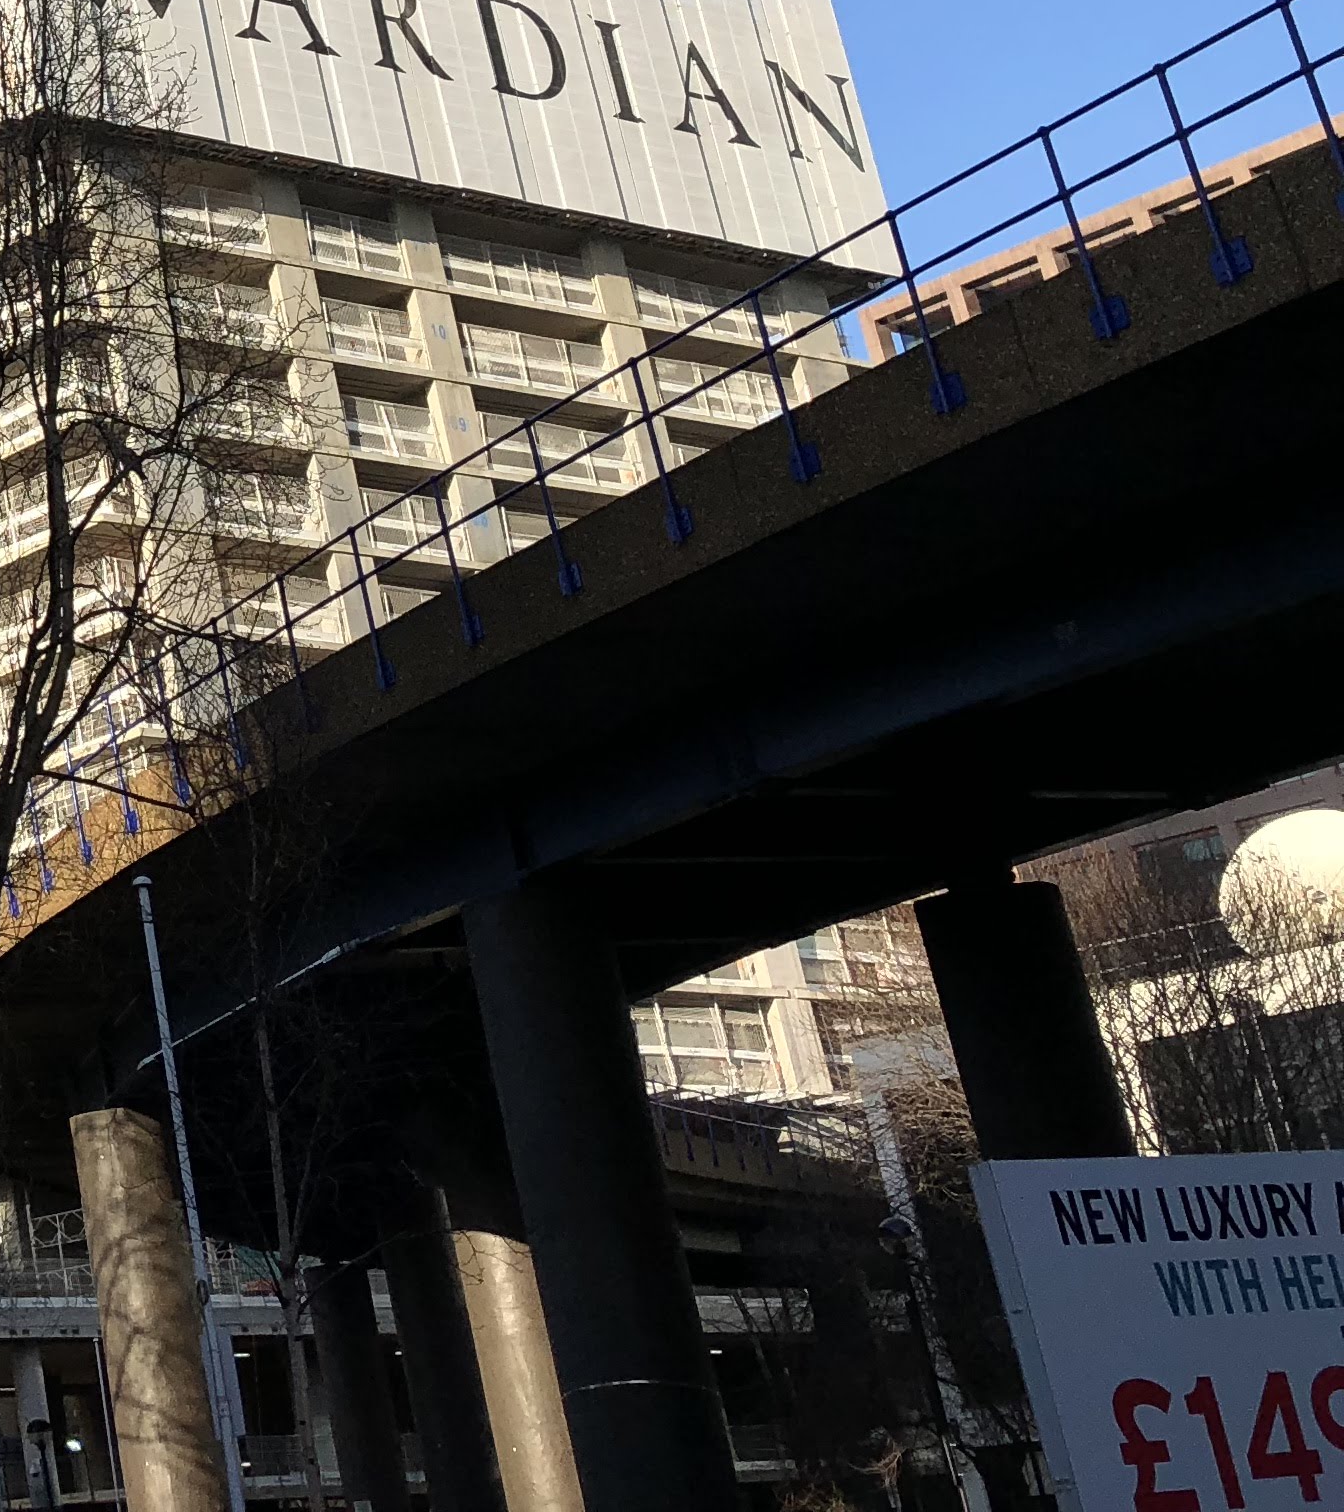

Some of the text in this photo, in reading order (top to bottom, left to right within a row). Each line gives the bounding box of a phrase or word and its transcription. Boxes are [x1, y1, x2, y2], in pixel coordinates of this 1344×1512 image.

[1050, 1188, 1147, 1245] NEW
[1156, 1182, 1318, 1242] LUXURY
[1154, 1257, 1269, 1317] WITH
